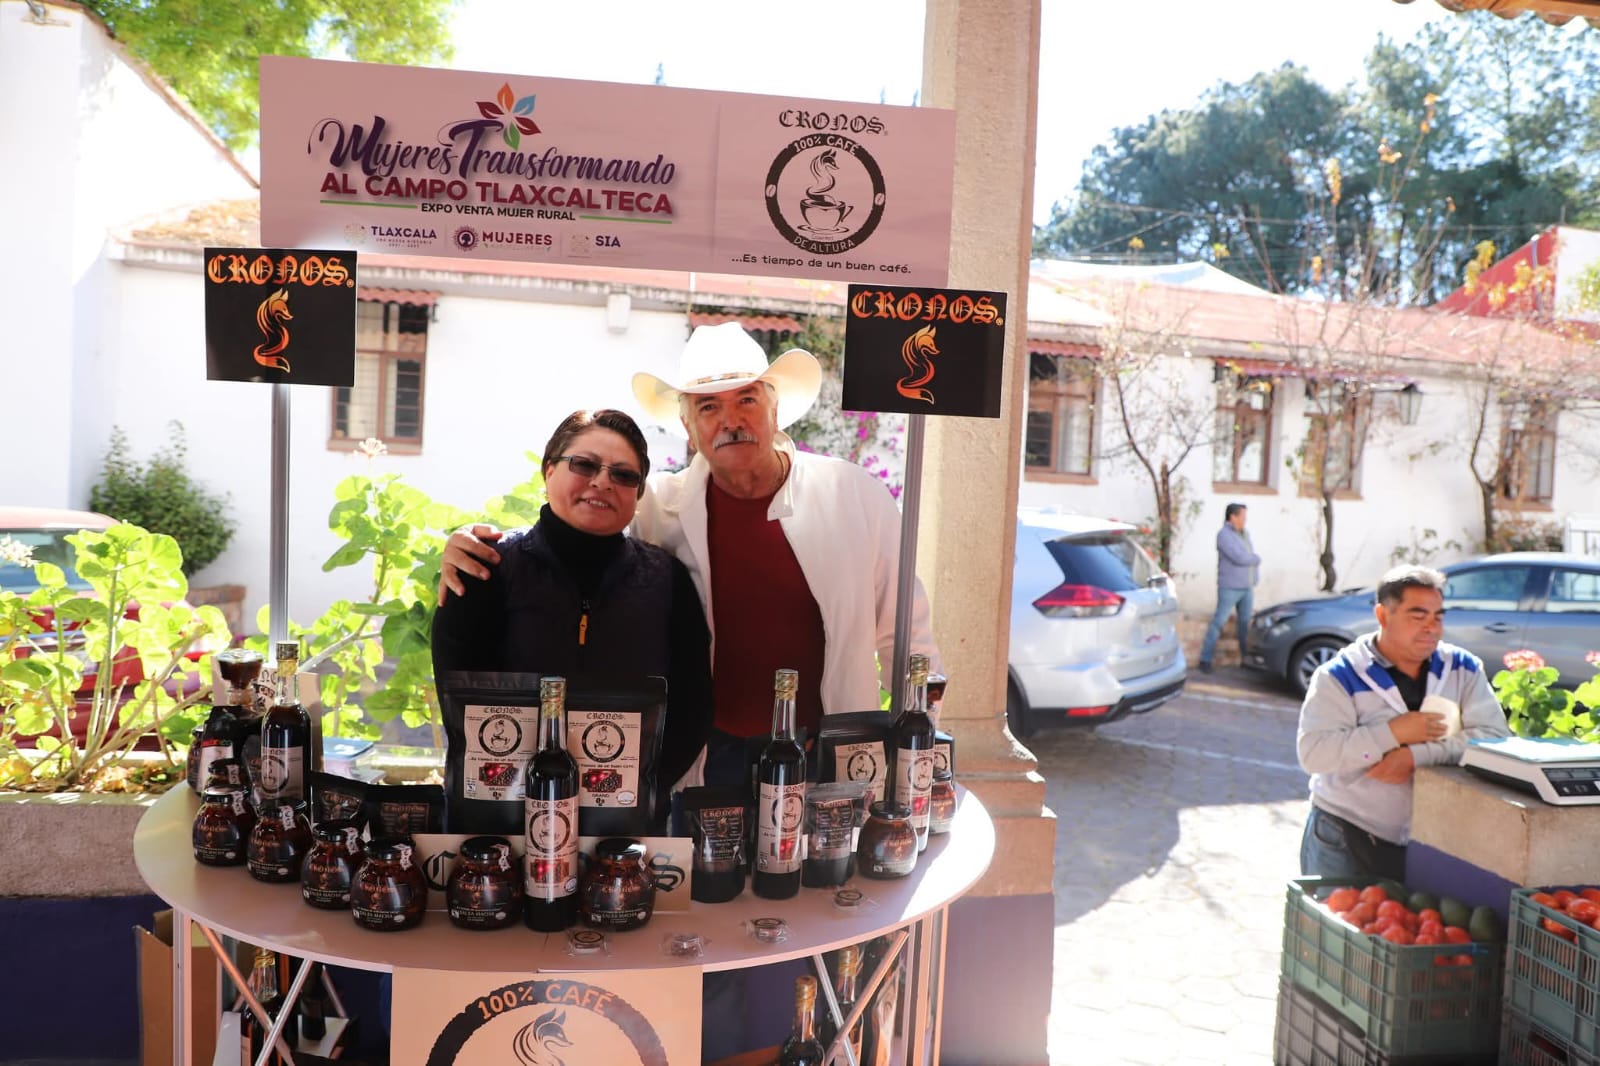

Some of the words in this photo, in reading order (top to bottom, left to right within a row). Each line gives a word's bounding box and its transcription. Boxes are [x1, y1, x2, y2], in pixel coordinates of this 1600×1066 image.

[308, 116, 457, 177] Mujeres
[437, 119, 675, 184] Transformando
[794, 136, 821, 152] 100%
[320, 172, 357, 195] AL
[365, 175, 468, 201] CAMPO
[475, 181, 673, 215] TLAXCALTECA
[421, 203, 452, 214] EXPO
[456, 205, 494, 216] VENTA
[497, 207, 536, 219] MUJER
[537, 209, 576, 221] RURAL
[371, 226, 437, 239] TLAXCALA
[482, 231, 553, 246] MUJERES
[595, 235, 621, 247] SIA
[794, 236, 808, 248] DE
[810, 239, 855, 253] ALTURA
[761, 255, 803, 267] tiempo
[807, 258, 823, 268] de
[826, 260, 842, 269] un
[846, 262, 876, 271] buen
[478, 985, 534, 1020] 100%
[545, 982, 617, 1016] CAFÉ
